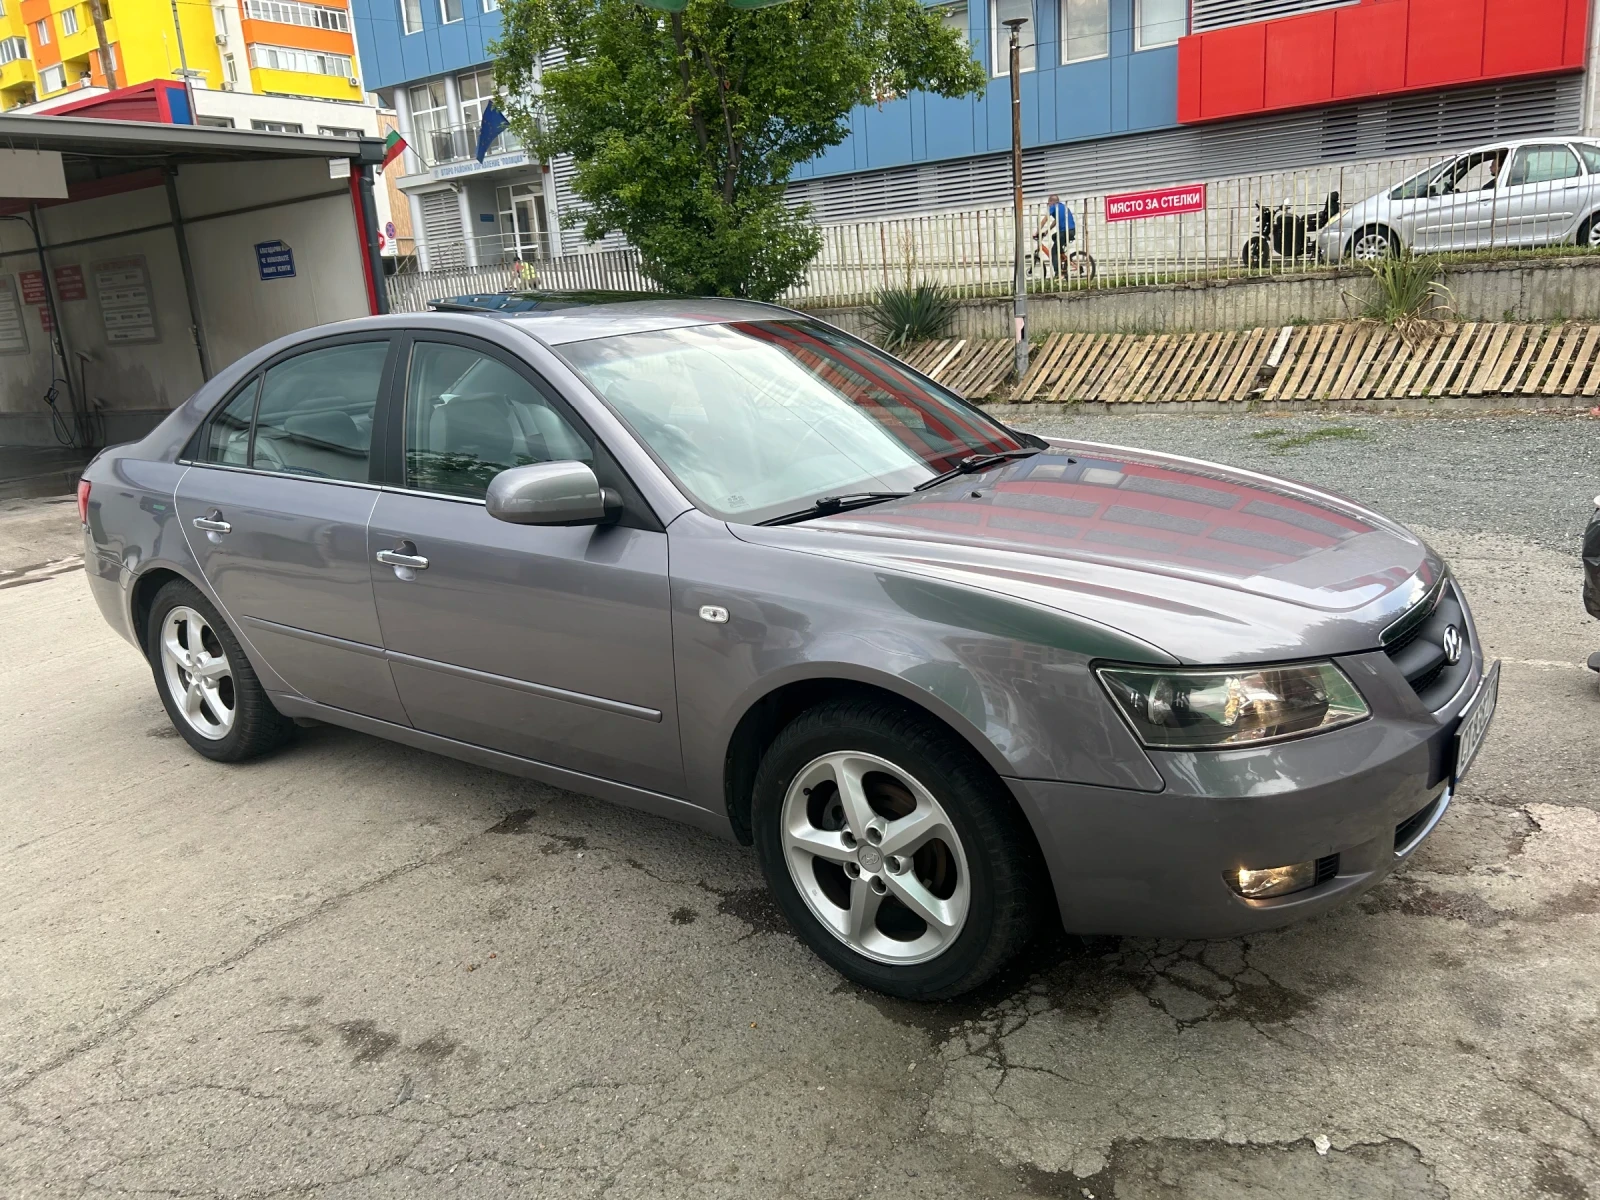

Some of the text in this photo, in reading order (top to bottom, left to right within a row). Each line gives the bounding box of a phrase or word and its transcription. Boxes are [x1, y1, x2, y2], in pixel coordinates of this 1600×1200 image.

[1110, 192, 1200, 214] МЯСТО ЗА СТЕЛКИ
